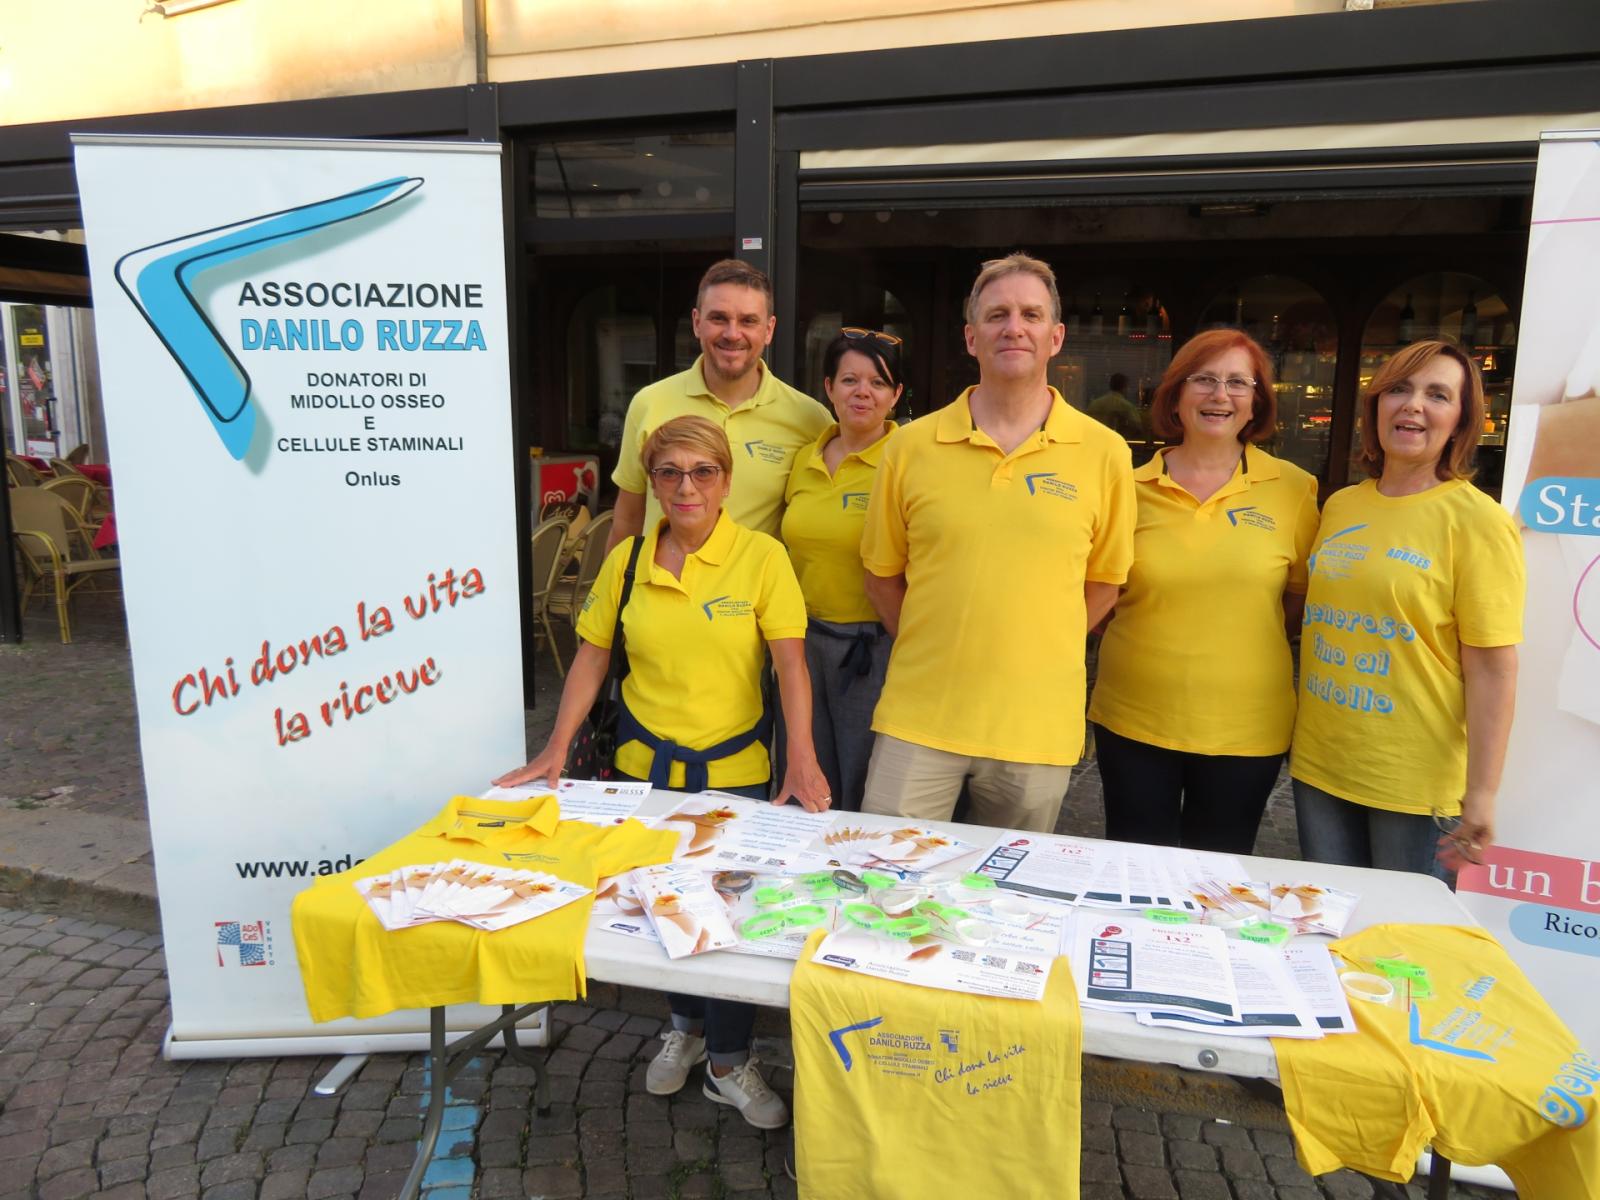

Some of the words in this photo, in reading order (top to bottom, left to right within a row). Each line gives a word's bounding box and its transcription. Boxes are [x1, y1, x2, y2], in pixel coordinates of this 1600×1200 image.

[238, 281, 484, 309] ASSOCIAZIONE
[240, 318, 364, 351] DANILO
[376, 319, 487, 352] RUZZA
[306, 372, 403, 388] DONATORI
[408, 372, 427, 387] DI
[290, 394, 376, 409] MIDOLLO
[380, 394, 446, 409] OSSEO
[363, 415, 376, 430] E
[277, 437, 361, 452] CELLULE
[366, 436, 464, 452] STAMINALI
[344, 471, 401, 486] Onlus
[172, 657, 241, 716] Chi
[250, 625, 349, 686] dona
[356, 600, 395, 641] la
[403, 567, 486, 620] vita
[1354, 649, 1391, 677] al
[273, 706, 312, 746] la
[319, 656, 443, 728] riceve
[1488, 863, 1553, 898] un
[869, 1037, 901, 1049] DANILO
[903, 1040, 932, 1052] RUZZA
[876, 1031, 924, 1043] ASSOCIAZIONE
[934, 1066, 955, 1084] Chi
[958, 1060, 986, 1077] dona
[987, 1050, 1001, 1064] la
[1004, 1044, 1026, 1060] vita
[966, 1082, 980, 1096] la
[983, 1074, 1013, 1089] riceve
